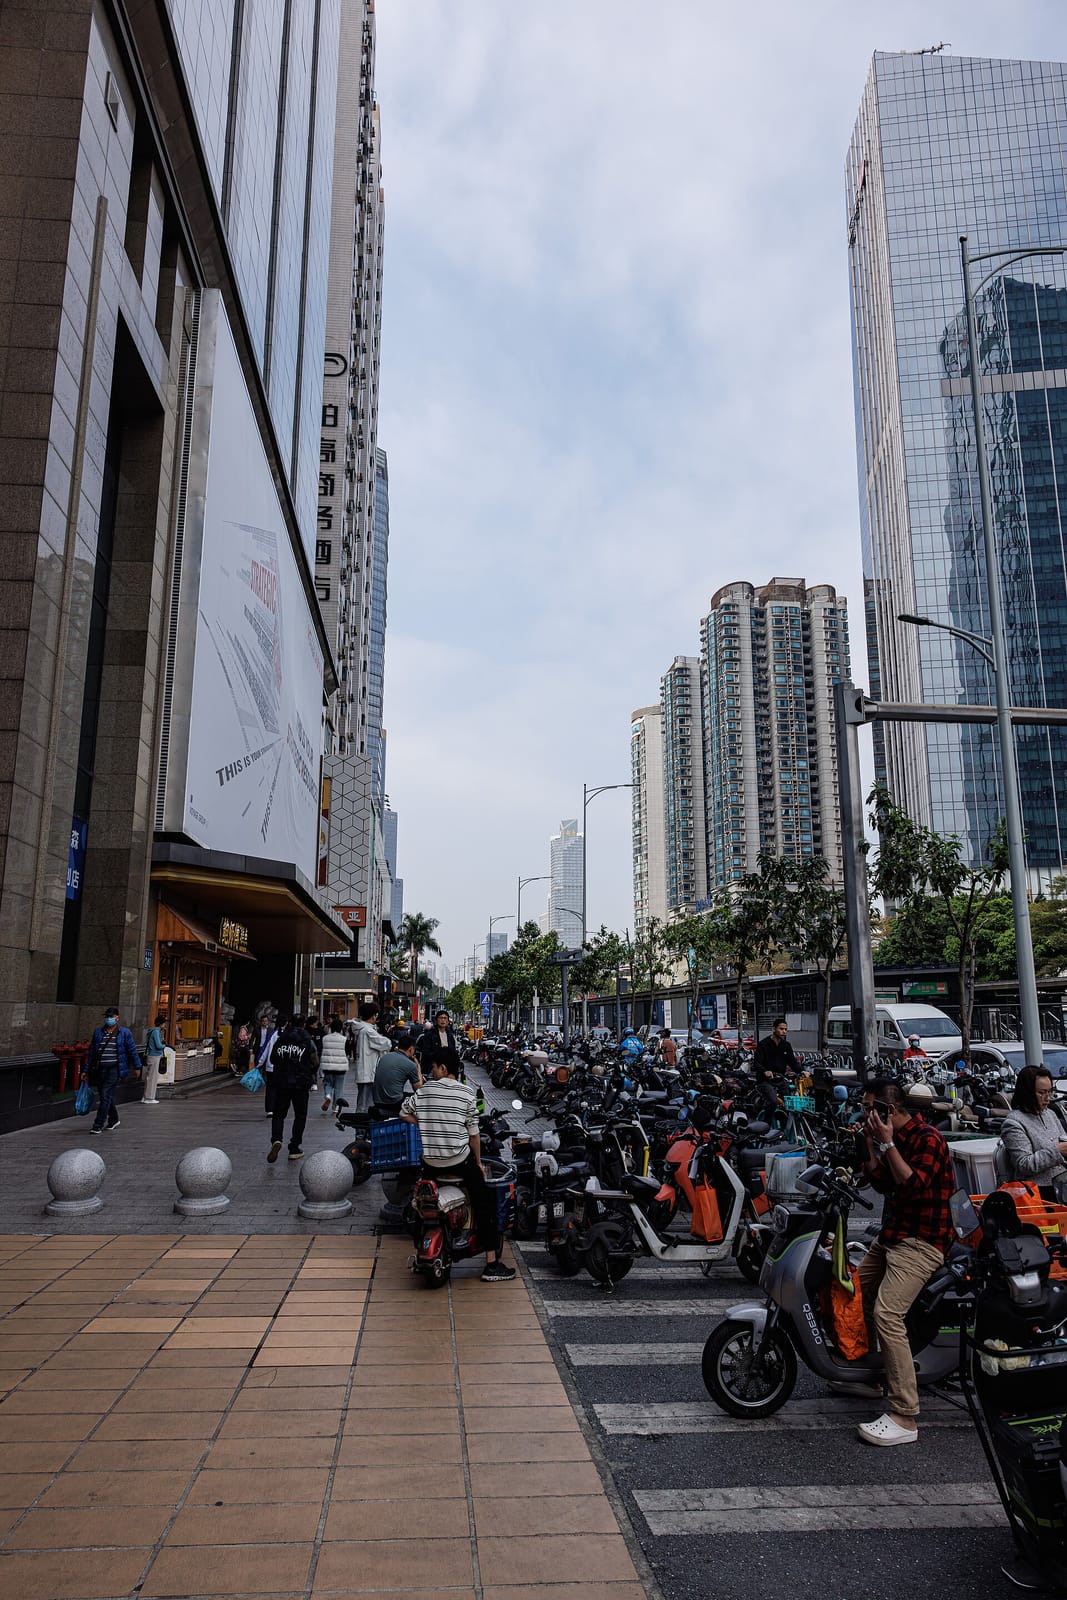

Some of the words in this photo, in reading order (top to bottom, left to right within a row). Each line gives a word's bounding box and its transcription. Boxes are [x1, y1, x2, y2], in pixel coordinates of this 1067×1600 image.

[215, 759, 243, 787] THIS
[243, 755, 251, 768] IS
[802, 1303, 823, 1345] QS300
